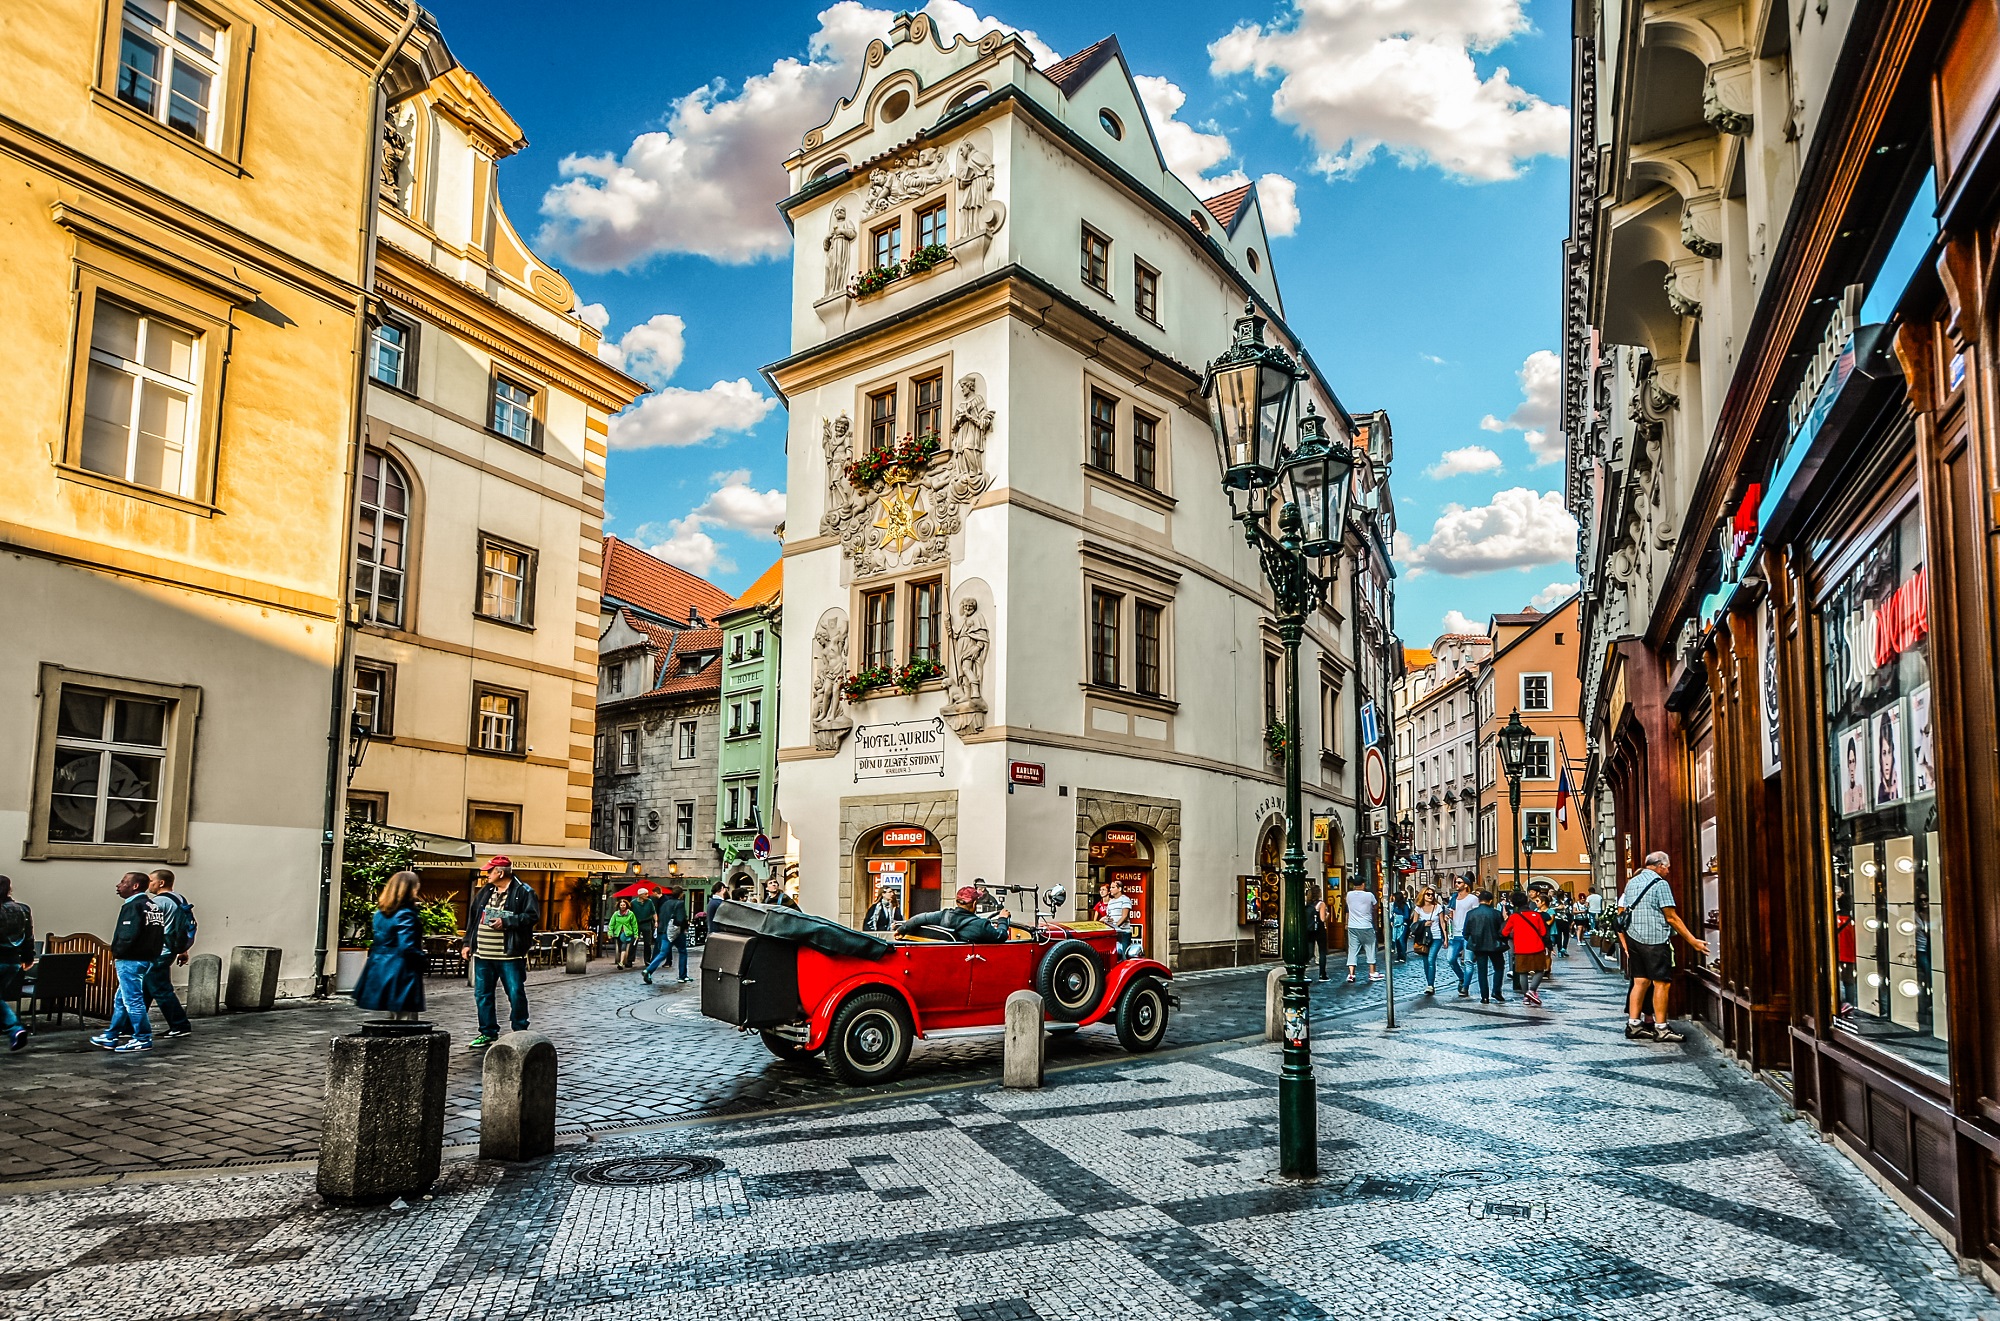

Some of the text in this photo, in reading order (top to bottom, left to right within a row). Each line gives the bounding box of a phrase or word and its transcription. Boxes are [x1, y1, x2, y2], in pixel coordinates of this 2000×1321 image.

[863, 730, 936, 749] HOTEL AURUS
[877, 758, 883, 766] U
[884, 755, 908, 768] ZLATÉ
[909, 754, 941, 766] STUDNY
[1016, 766, 1040, 776] KARLOVA
[885, 831, 923, 843] change
[1107, 833, 1135, 841] CHANGE
[512, 861, 619, 871] RESTAURANT CLEMENTIN
[879, 861, 896, 872] ATM
[884, 876, 902, 884] ATM
[1122, 885, 1144, 893] CHSEL
[1129, 910, 1141, 919] BIO
